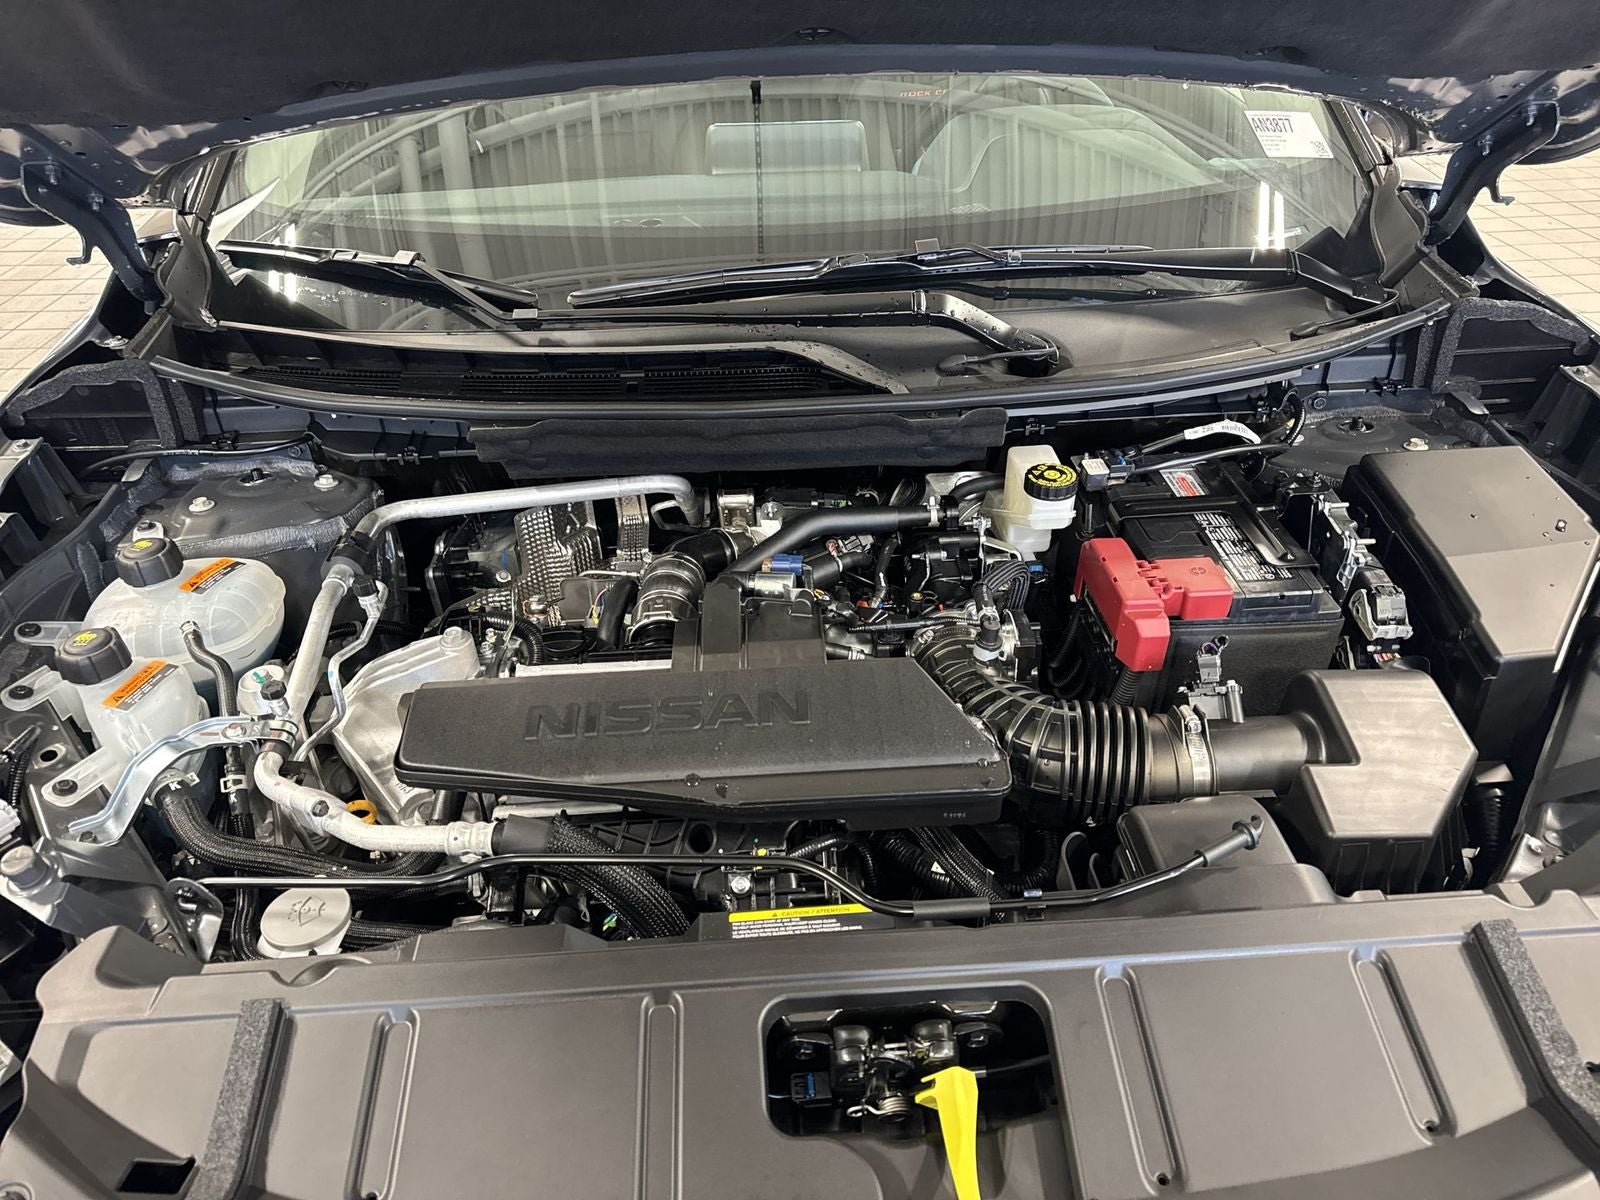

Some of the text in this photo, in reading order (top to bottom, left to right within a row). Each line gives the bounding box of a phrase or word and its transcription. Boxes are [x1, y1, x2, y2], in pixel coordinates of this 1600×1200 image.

[1251, 117, 1294, 133] AN3877
[523, 690, 812, 742] NISSAN
[782, 909, 810, 917] CAUTION
[815, 907, 850, 915] ATTENTION
